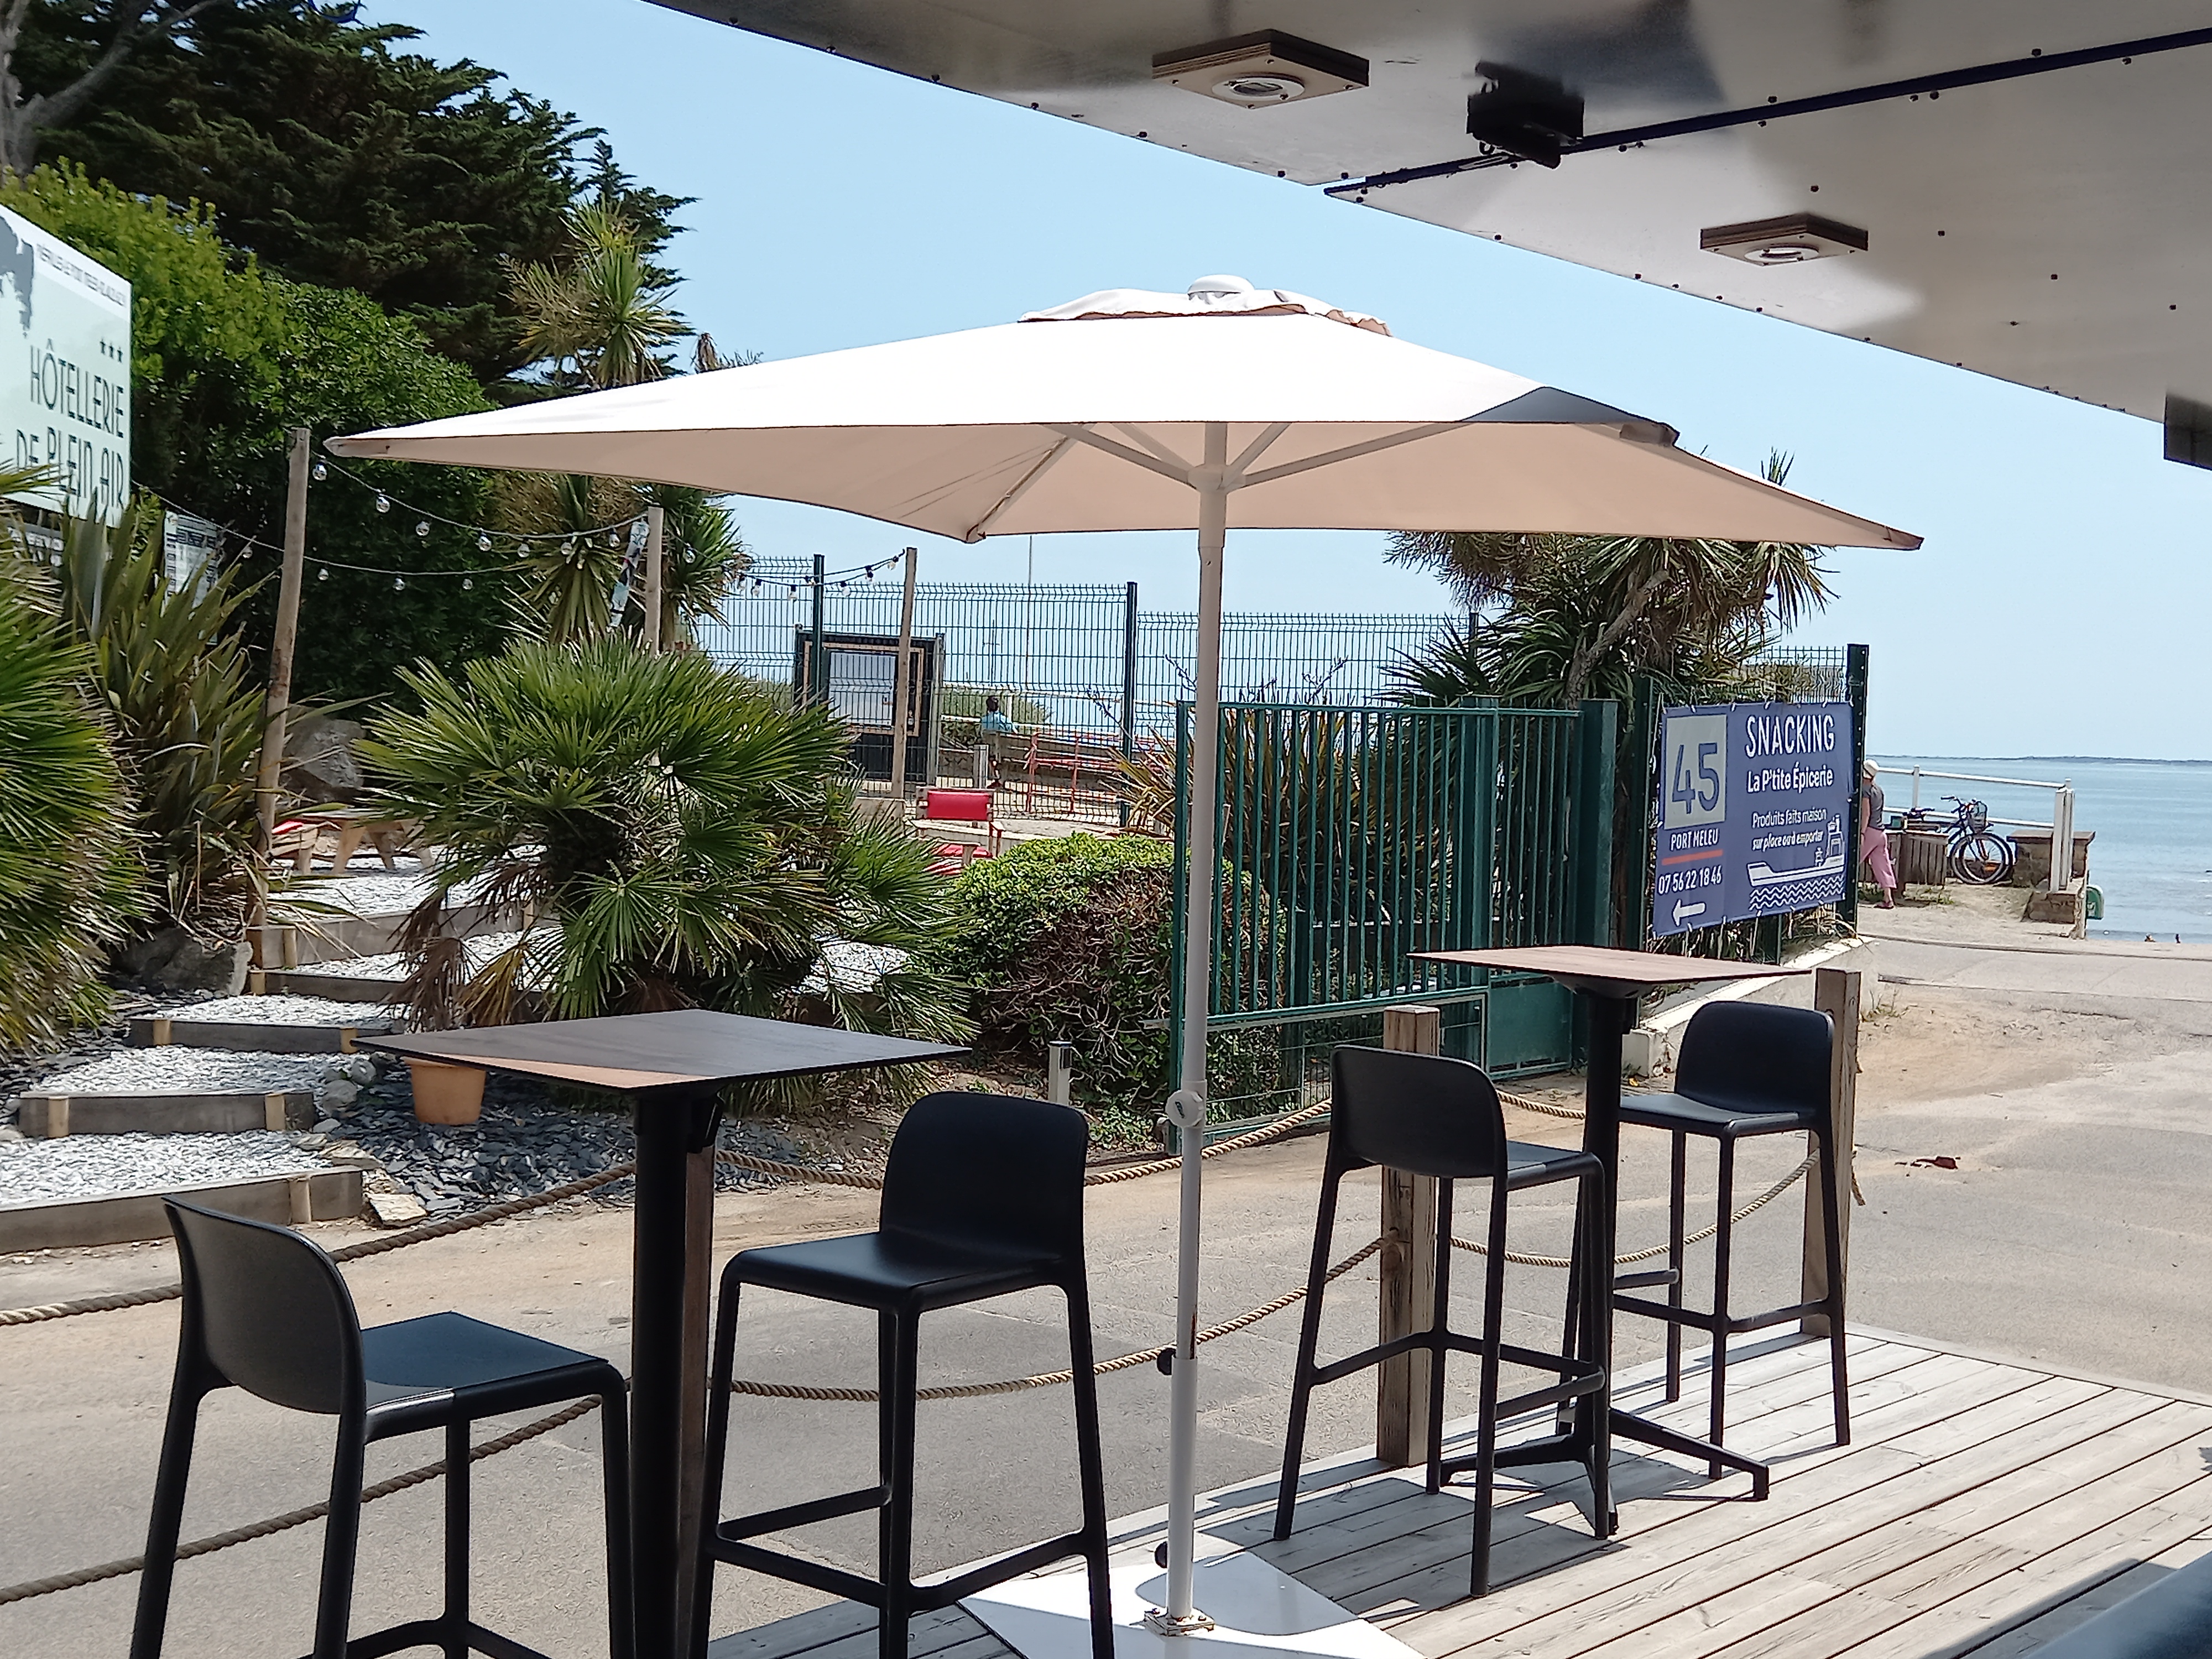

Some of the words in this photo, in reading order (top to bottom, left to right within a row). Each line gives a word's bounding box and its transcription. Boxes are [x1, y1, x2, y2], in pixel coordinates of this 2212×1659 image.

[30, 338, 123, 439] HÔTELLERIE
[17, 429, 39, 471] DE
[47, 426, 92, 499] PLEIN
[100, 447, 124, 510] AIR
[1745, 714, 1834, 758] SNACKING
[1671, 742, 1720, 815] 45
[1747, 770, 1760, 792] La
[1762, 768, 1791, 791] P'tite
[1793, 761, 1834, 794] Épicerie
[1752, 811, 1785, 828] Produits
[1786, 808, 1802, 825] faits
[1802, 806, 1827, 822] maison
[1670, 831, 1692, 851] PORT
[1752, 838, 1763, 851] sur
[1762, 832, 1782, 852] place
[1658, 874, 1671, 894] 07
[1672, 872, 1684, 891] 56
[1685, 870, 1697, 890] 22
[1699, 867, 1710, 888] 18
[1711, 865, 1722, 885] 46
